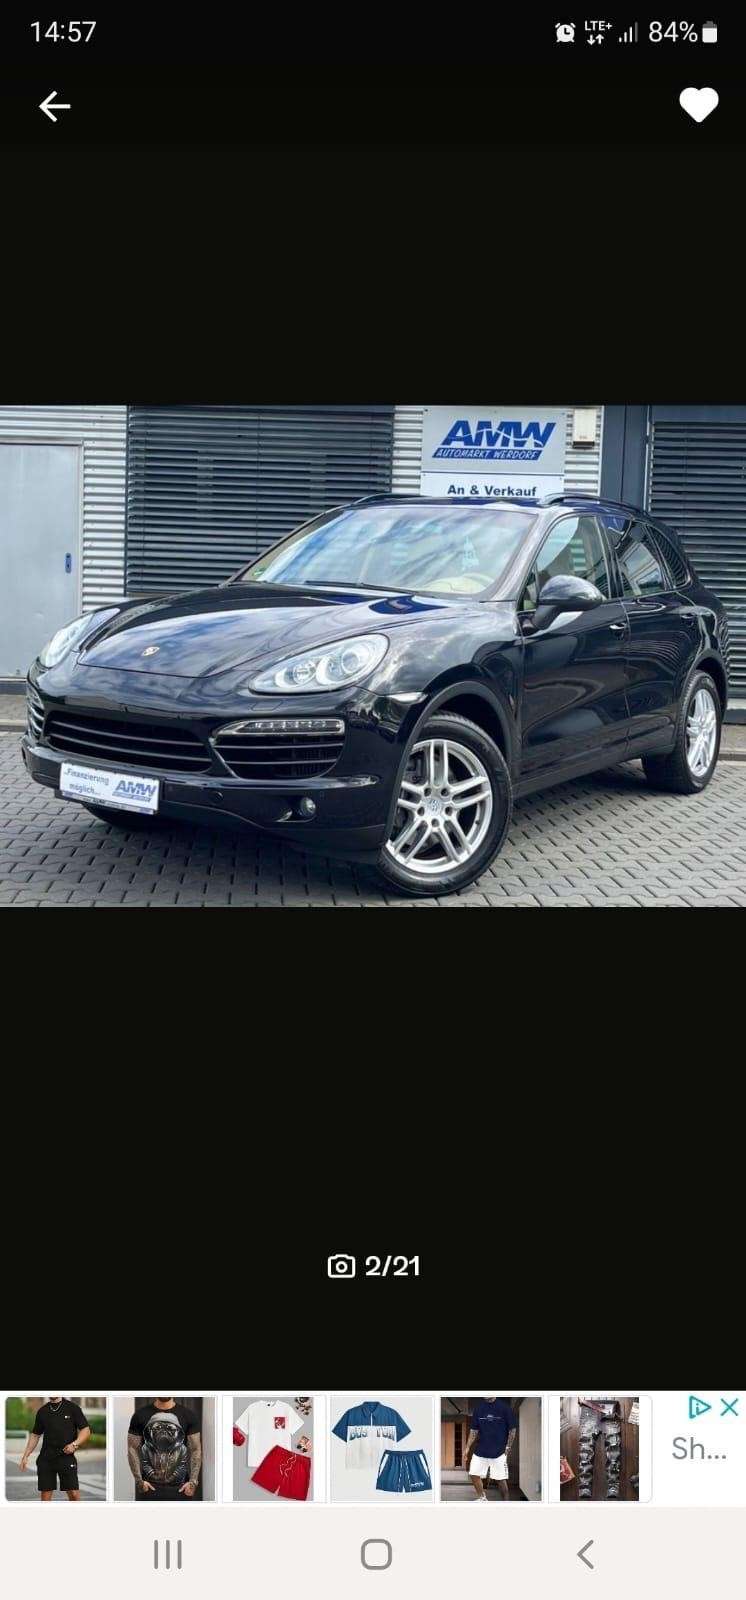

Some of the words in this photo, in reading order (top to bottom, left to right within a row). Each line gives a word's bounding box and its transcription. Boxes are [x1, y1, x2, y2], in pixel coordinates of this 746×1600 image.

[441, 420, 556, 448] AMW
[435, 448, 490, 459] AUTOMARKT
[493, 449, 538, 460] WERDORF
[447, 484, 465, 496] An
[469, 485, 479, 496] &
[485, 485, 539, 497] Verkauf
[115, 780, 157, 797] AMW
